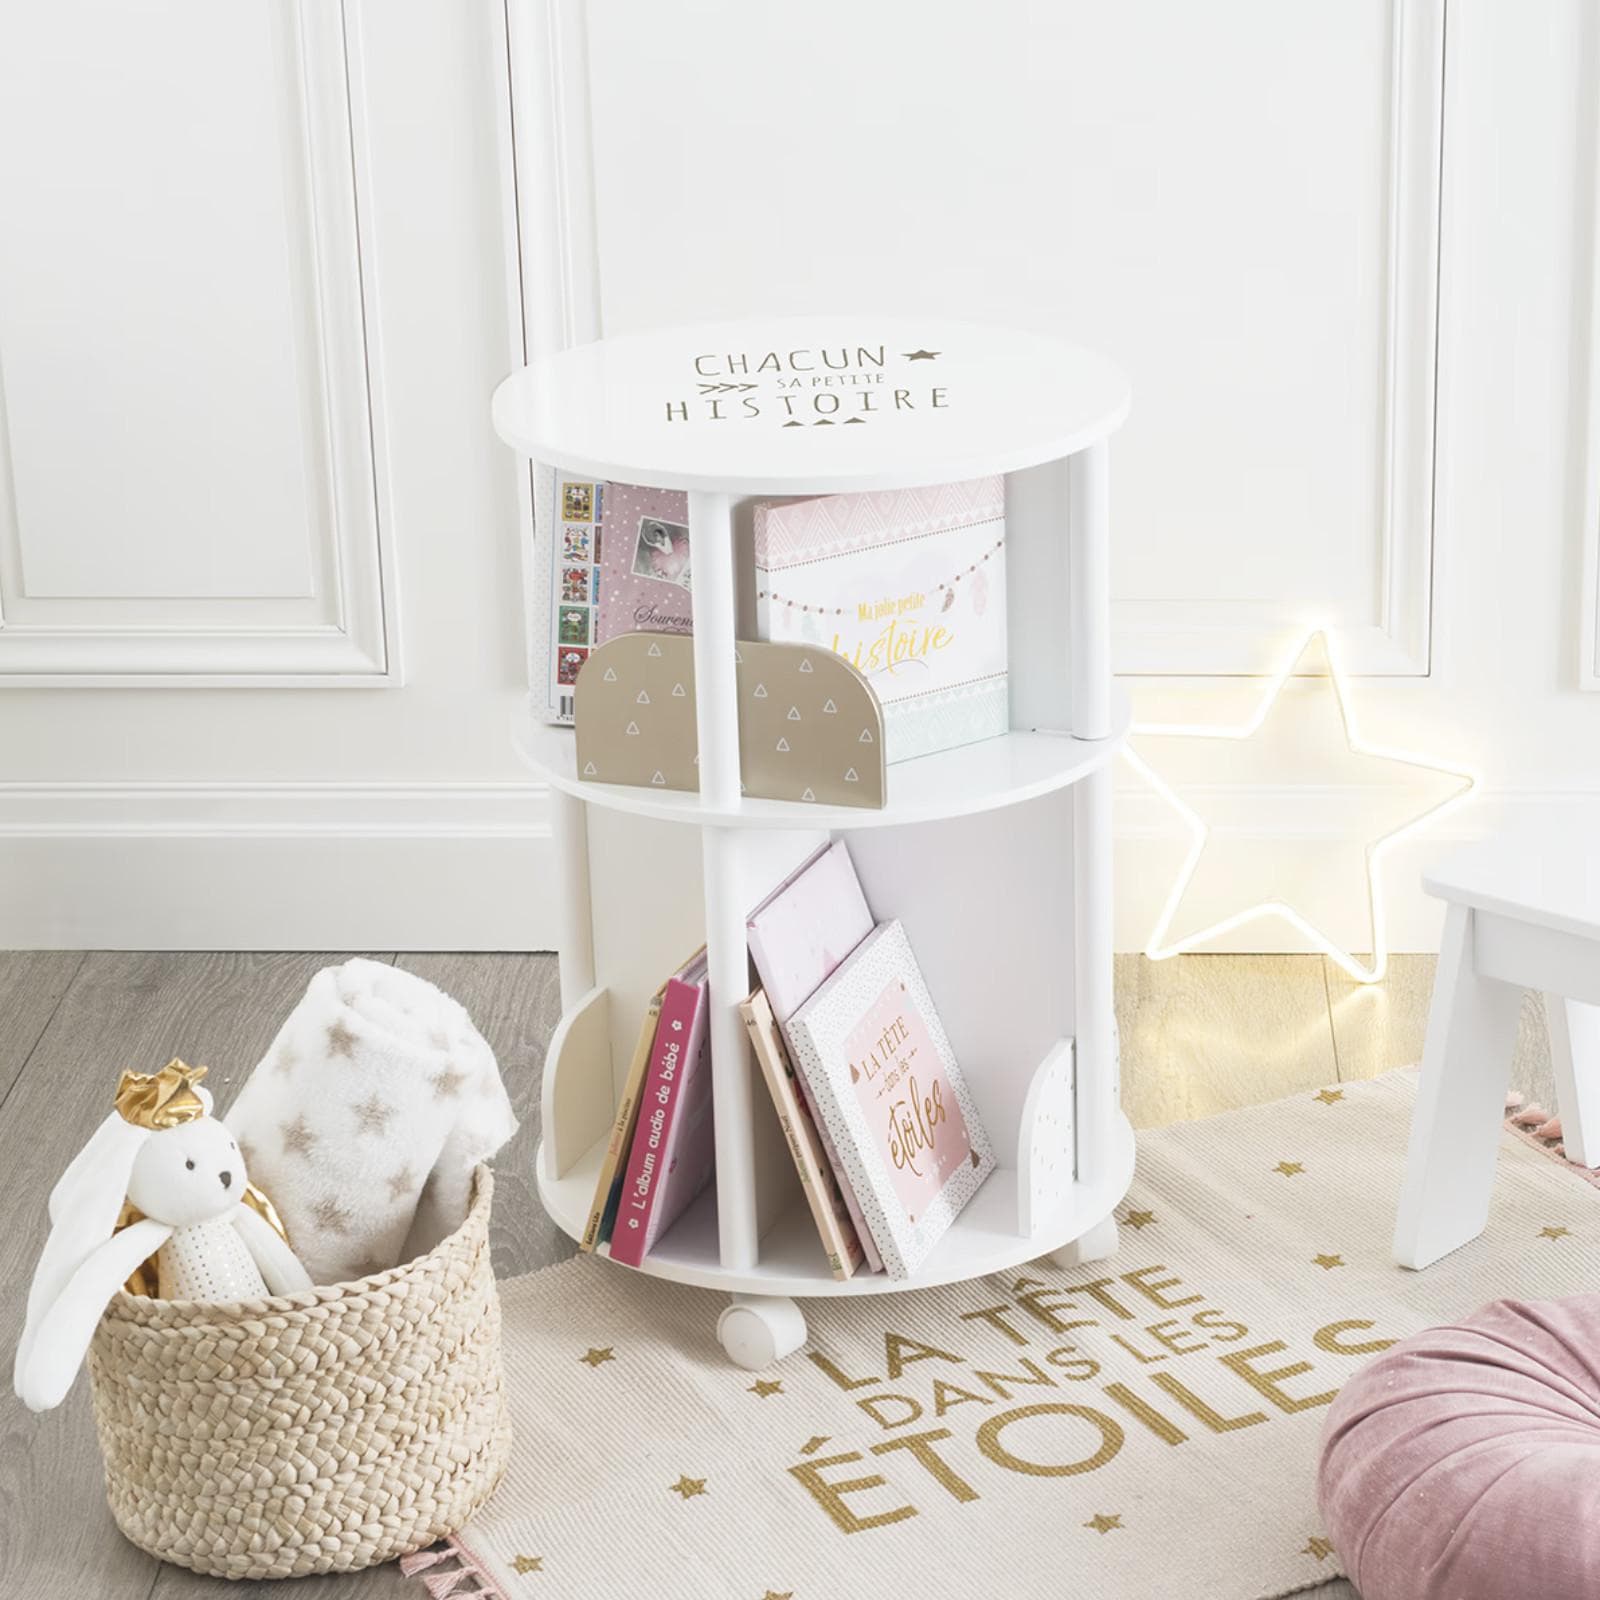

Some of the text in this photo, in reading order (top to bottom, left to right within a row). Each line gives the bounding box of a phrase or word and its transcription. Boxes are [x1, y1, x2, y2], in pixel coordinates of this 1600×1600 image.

[695, 345, 885, 376] CHACUN
[776, 373, 885, 388] SA PETITE
[665, 387, 949, 422] HISTOIRE
[861, 1015, 909, 1081] LA TÊTE
[631, 1042, 680, 1210] L'album audio de bébé
[887, 1075, 946, 1178] étoiles
[807, 1265, 1205, 1392] LA TÊTE
[856, 1309, 1249, 1430] DANS LES
